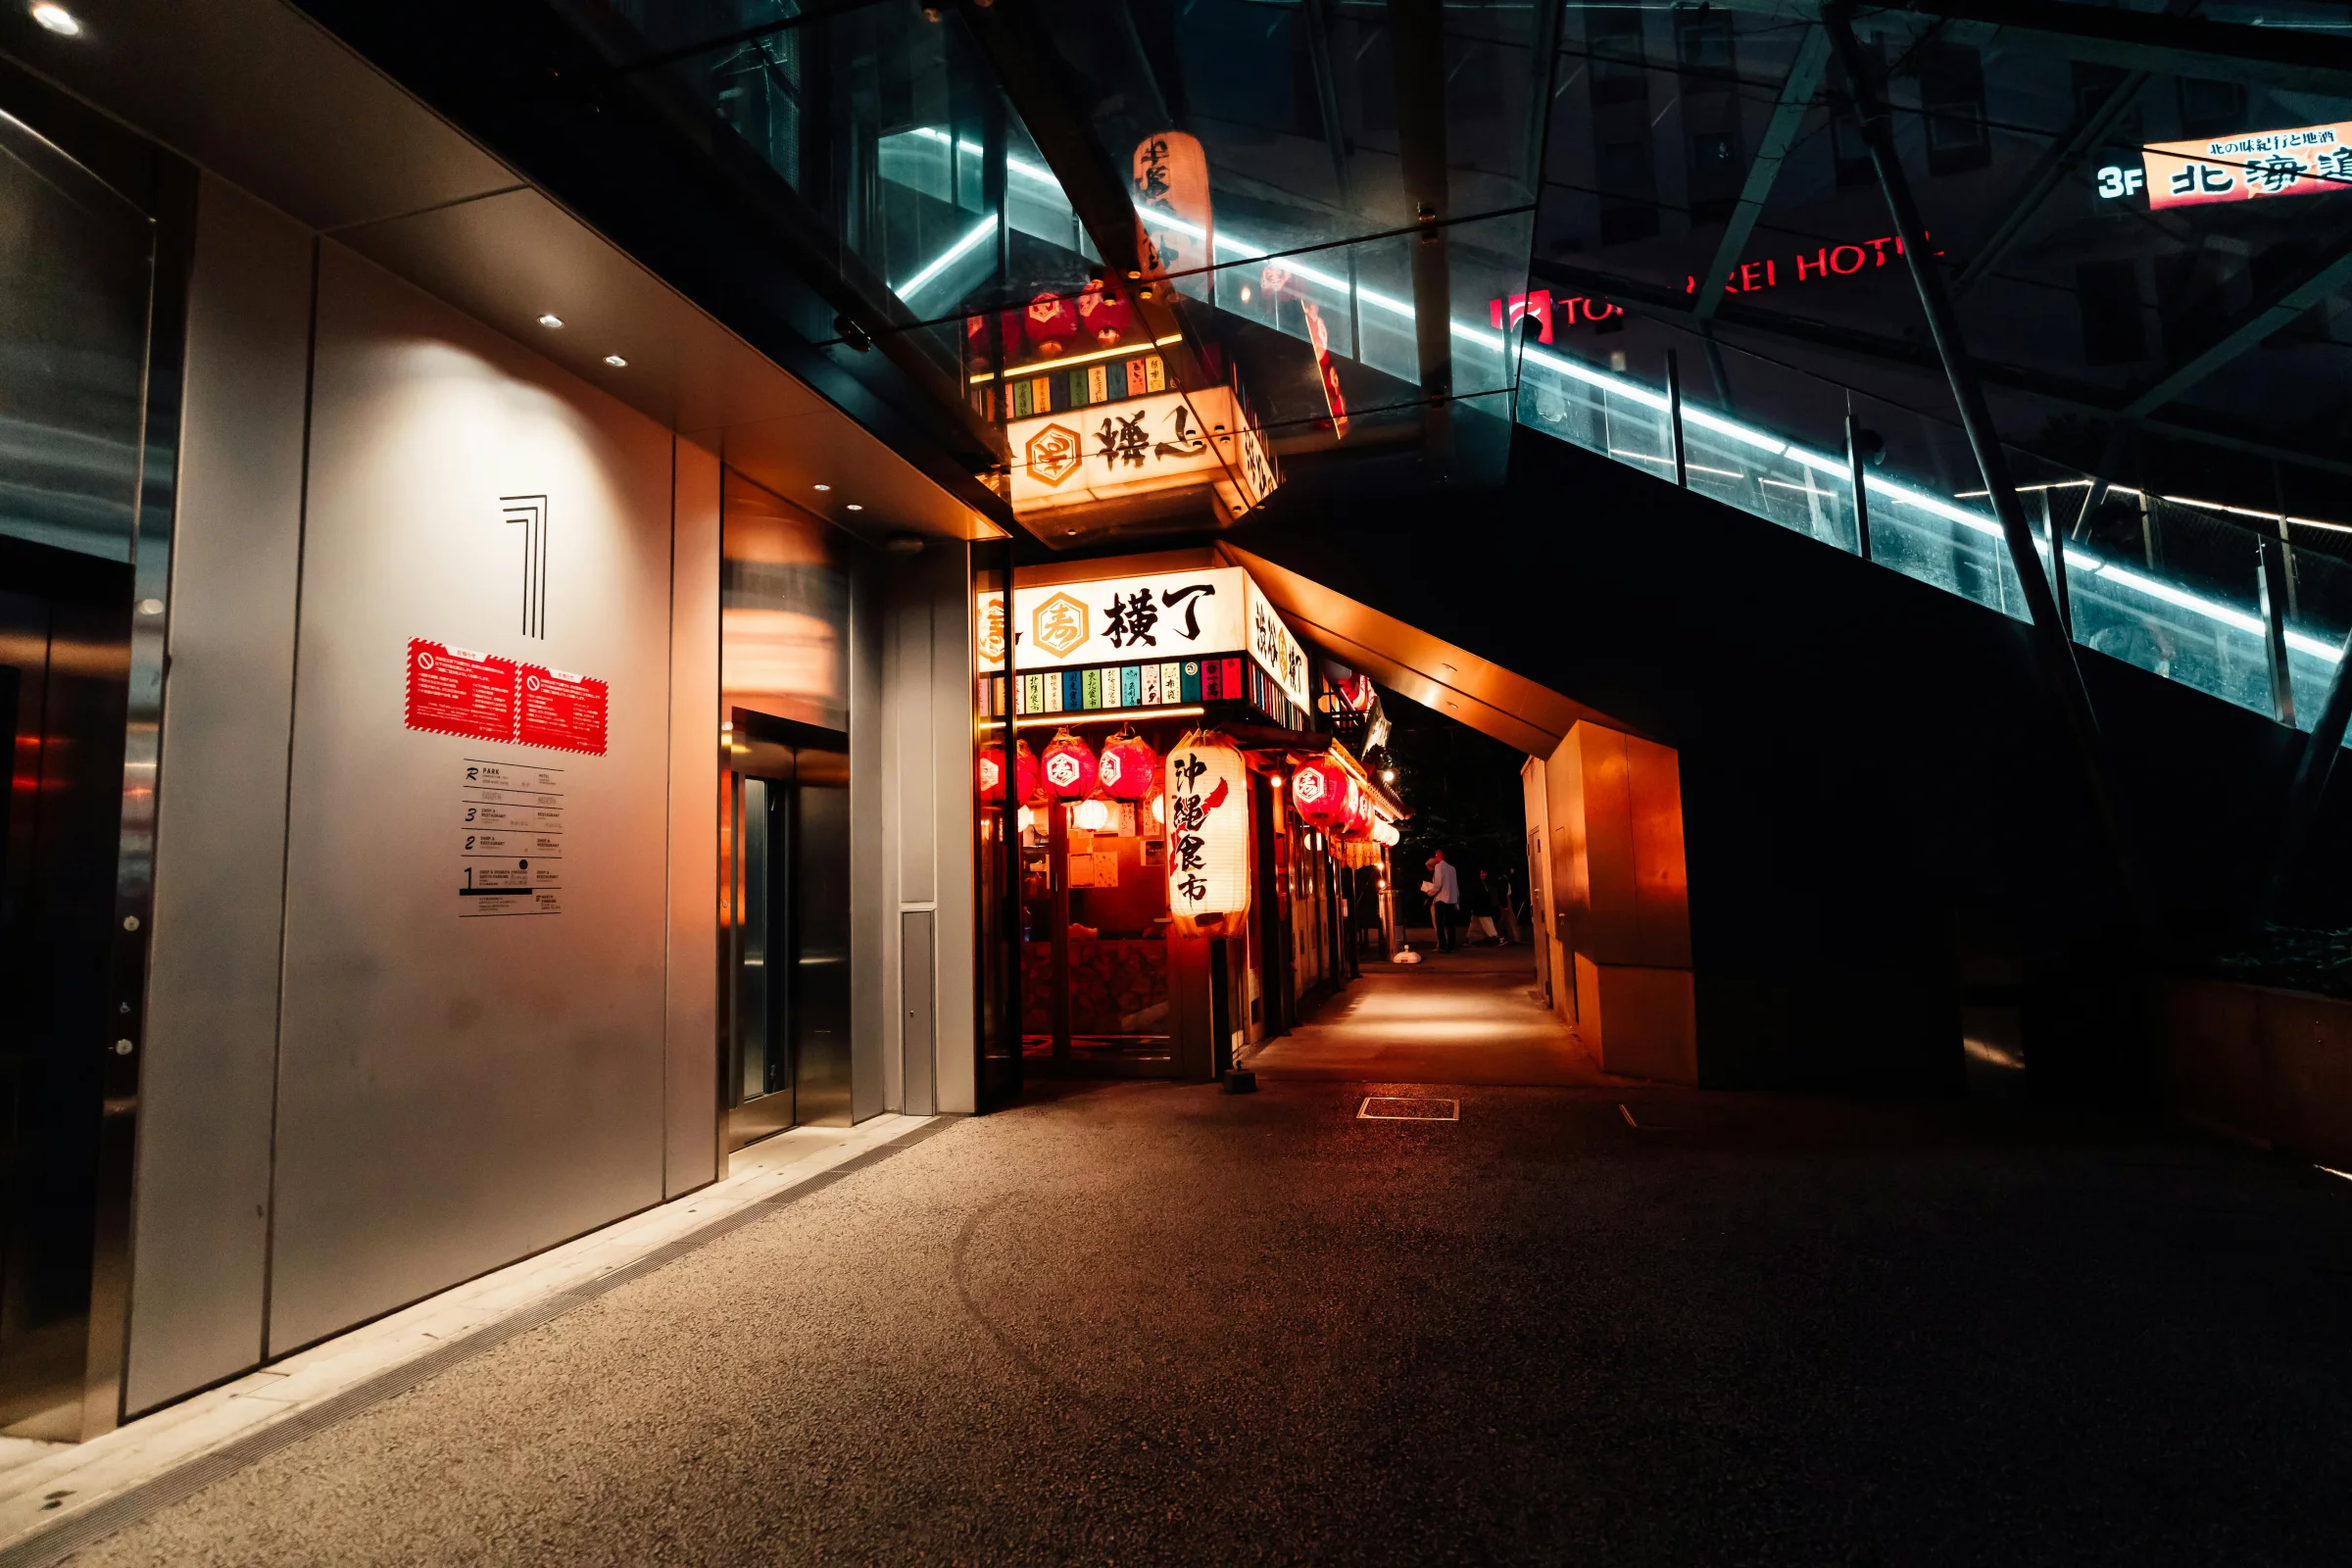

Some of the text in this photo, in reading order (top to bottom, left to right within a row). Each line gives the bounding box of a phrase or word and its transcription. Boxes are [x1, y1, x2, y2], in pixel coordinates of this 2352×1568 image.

[2210, 130, 2334, 154] 北の味紀行と地酒
[2097, 167, 2143, 199] 3F
[1101, 584, 1216, 649] 横丁
[466, 767, 479, 781] R
[465, 808, 477, 822] 3
[465, 836, 475, 850] 2
[1172, 753, 1210, 910] 沖縄食市
[464, 867, 472, 889] 1
